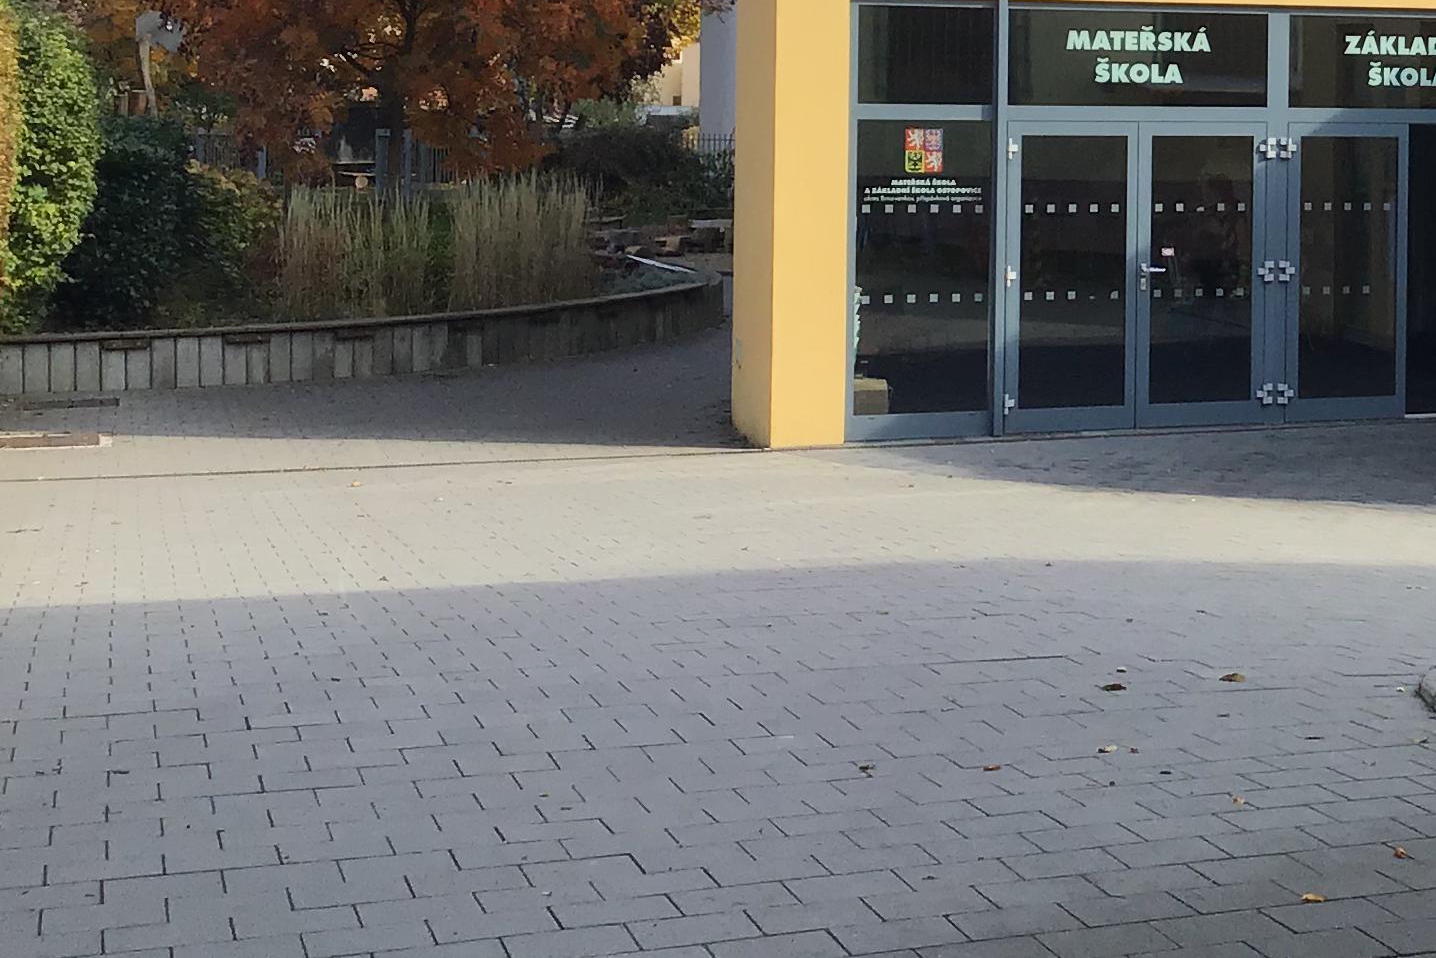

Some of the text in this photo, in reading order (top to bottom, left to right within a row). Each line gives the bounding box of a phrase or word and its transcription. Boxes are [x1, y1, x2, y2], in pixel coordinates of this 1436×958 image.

[1066, 25, 1211, 52] MATEŘSKÁ
[1094, 57, 1183, 84] ŠKOLA
[871, 186, 910, 194] ZÁKLADNÍ
[911, 186, 935, 194] ŠKOLA
[891, 178, 957, 186] MATEŘSKÁ ŠKOLA
